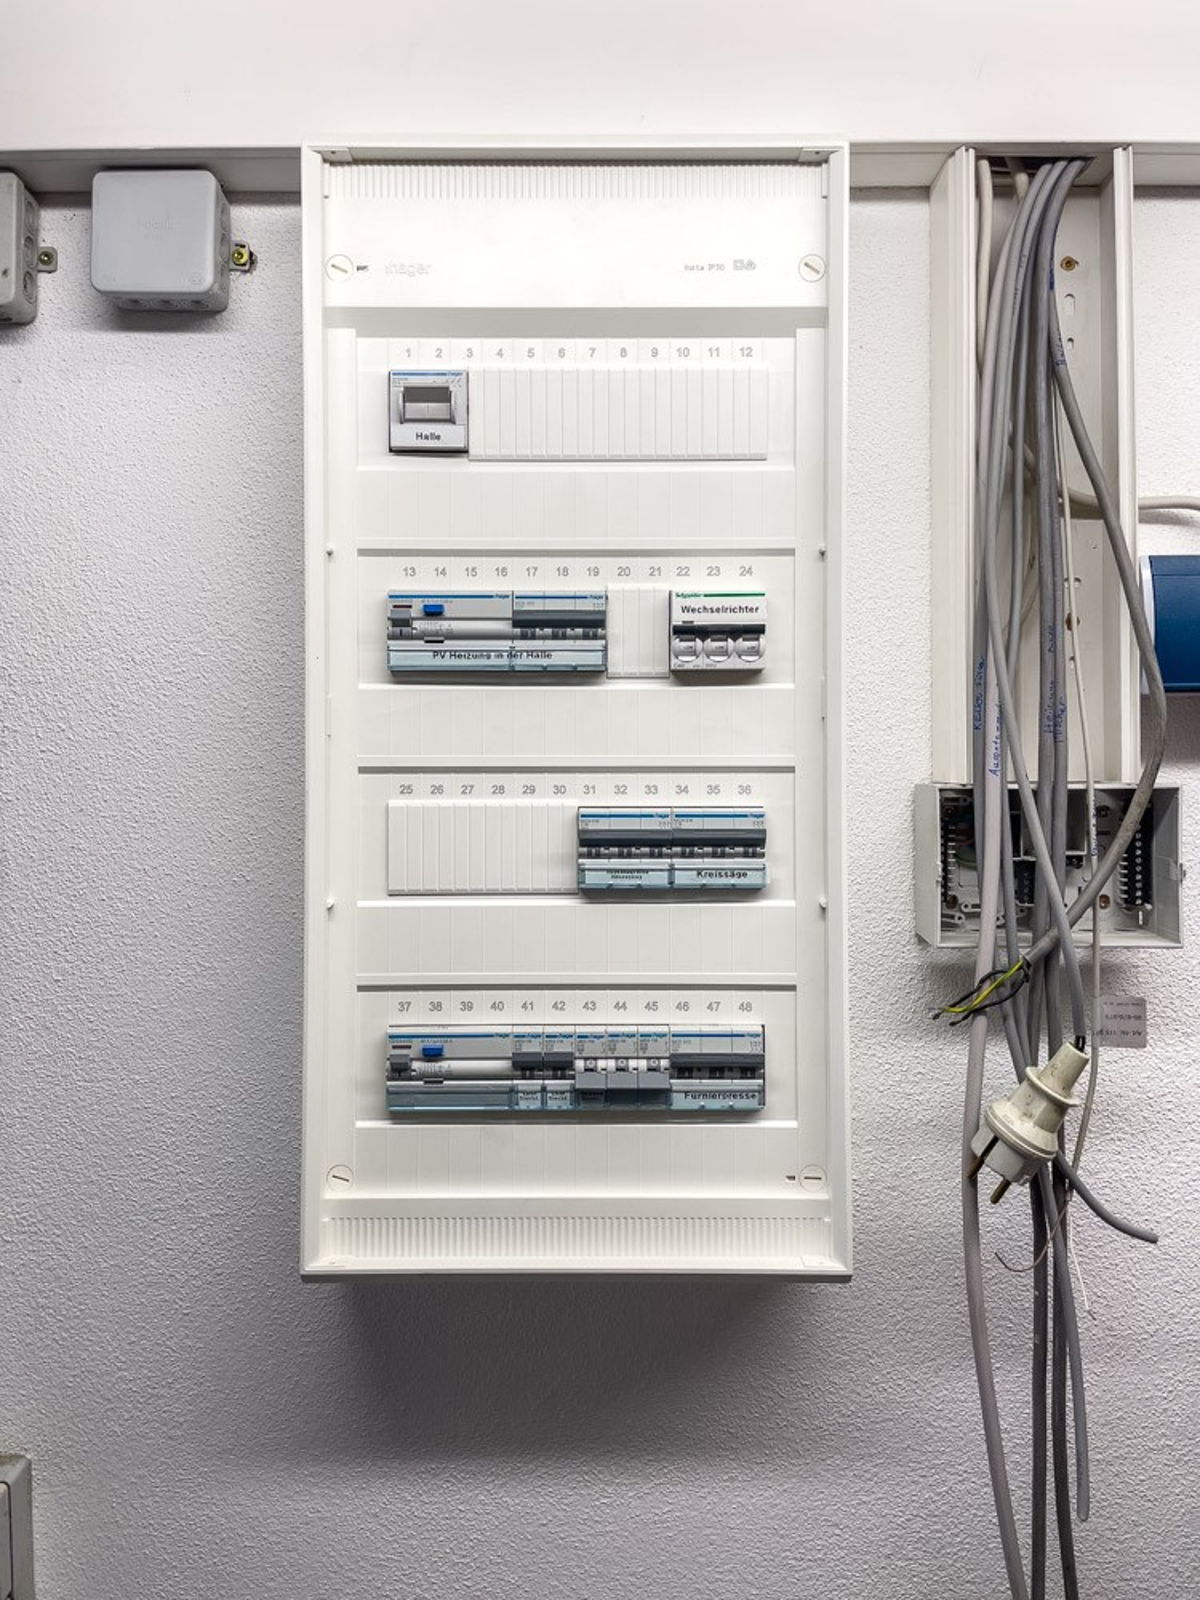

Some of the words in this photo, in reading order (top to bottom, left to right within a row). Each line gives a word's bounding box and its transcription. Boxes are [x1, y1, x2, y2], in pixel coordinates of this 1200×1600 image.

[405, 348, 411, 358] 1
[435, 347, 443, 359] 2
[466, 347, 474, 359] 3
[496, 347, 504, 359] 4
[527, 347, 535, 359] 5
[557, 347, 566, 359] 6
[589, 347, 597, 358] 7
[619, 347, 628, 358] 8
[650, 346, 659, 358] 9
[676, 346, 690, 358] 10
[708, 346, 720, 358] 11
[739, 346, 753, 358] 12
[415, 431, 442, 441] Halle
[402, 566, 417, 578] 13
[434, 566, 448, 577] 14
[465, 566, 478, 577] 15
[495, 566, 508, 578] 16
[525, 566, 539, 577] 17
[556, 566, 569, 577] 18
[586, 566, 600, 577] 19
[616, 565, 632, 577] 20
[648, 565, 662, 577] 21
[676, 565, 691, 577] 22
[706, 565, 721, 577] 23
[739, 565, 753, 577] 24
[681, 605, 760, 614] Wechselrichter
[432, 650, 447, 660] PV
[449, 650, 491, 661] Heizung
[507, 650, 525, 660] der
[526, 650, 554, 660] Halle
[399, 783, 414, 795] 25
[429, 783, 445, 796] 26
[460, 784, 475, 796] 27
[491, 784, 506, 796] 28
[521, 783, 537, 796] 29
[552, 784, 567, 796] 30
[583, 783, 596, 795] 31
[613, 783, 628, 795] 32
[644, 783, 659, 796] 33
[675, 784, 690, 795] 34
[706, 784, 721, 796] 35
[737, 784, 752, 796] 36
[397, 1000, 412, 1013] 37
[428, 1000, 443, 1012] 38
[459, 1000, 474, 1012] 39
[489, 1000, 505, 1012] 40
[520, 1000, 534, 1012] 41
[551, 1000, 566, 1012] 42
[582, 999, 597, 1012] 43
[613, 1000, 628, 1012] 44
[643, 1000, 659, 1012] 45
[675, 1000, 690, 1013] 46
[706, 1000, 721, 1012] 47
[737, 1000, 753, 1013] 48
